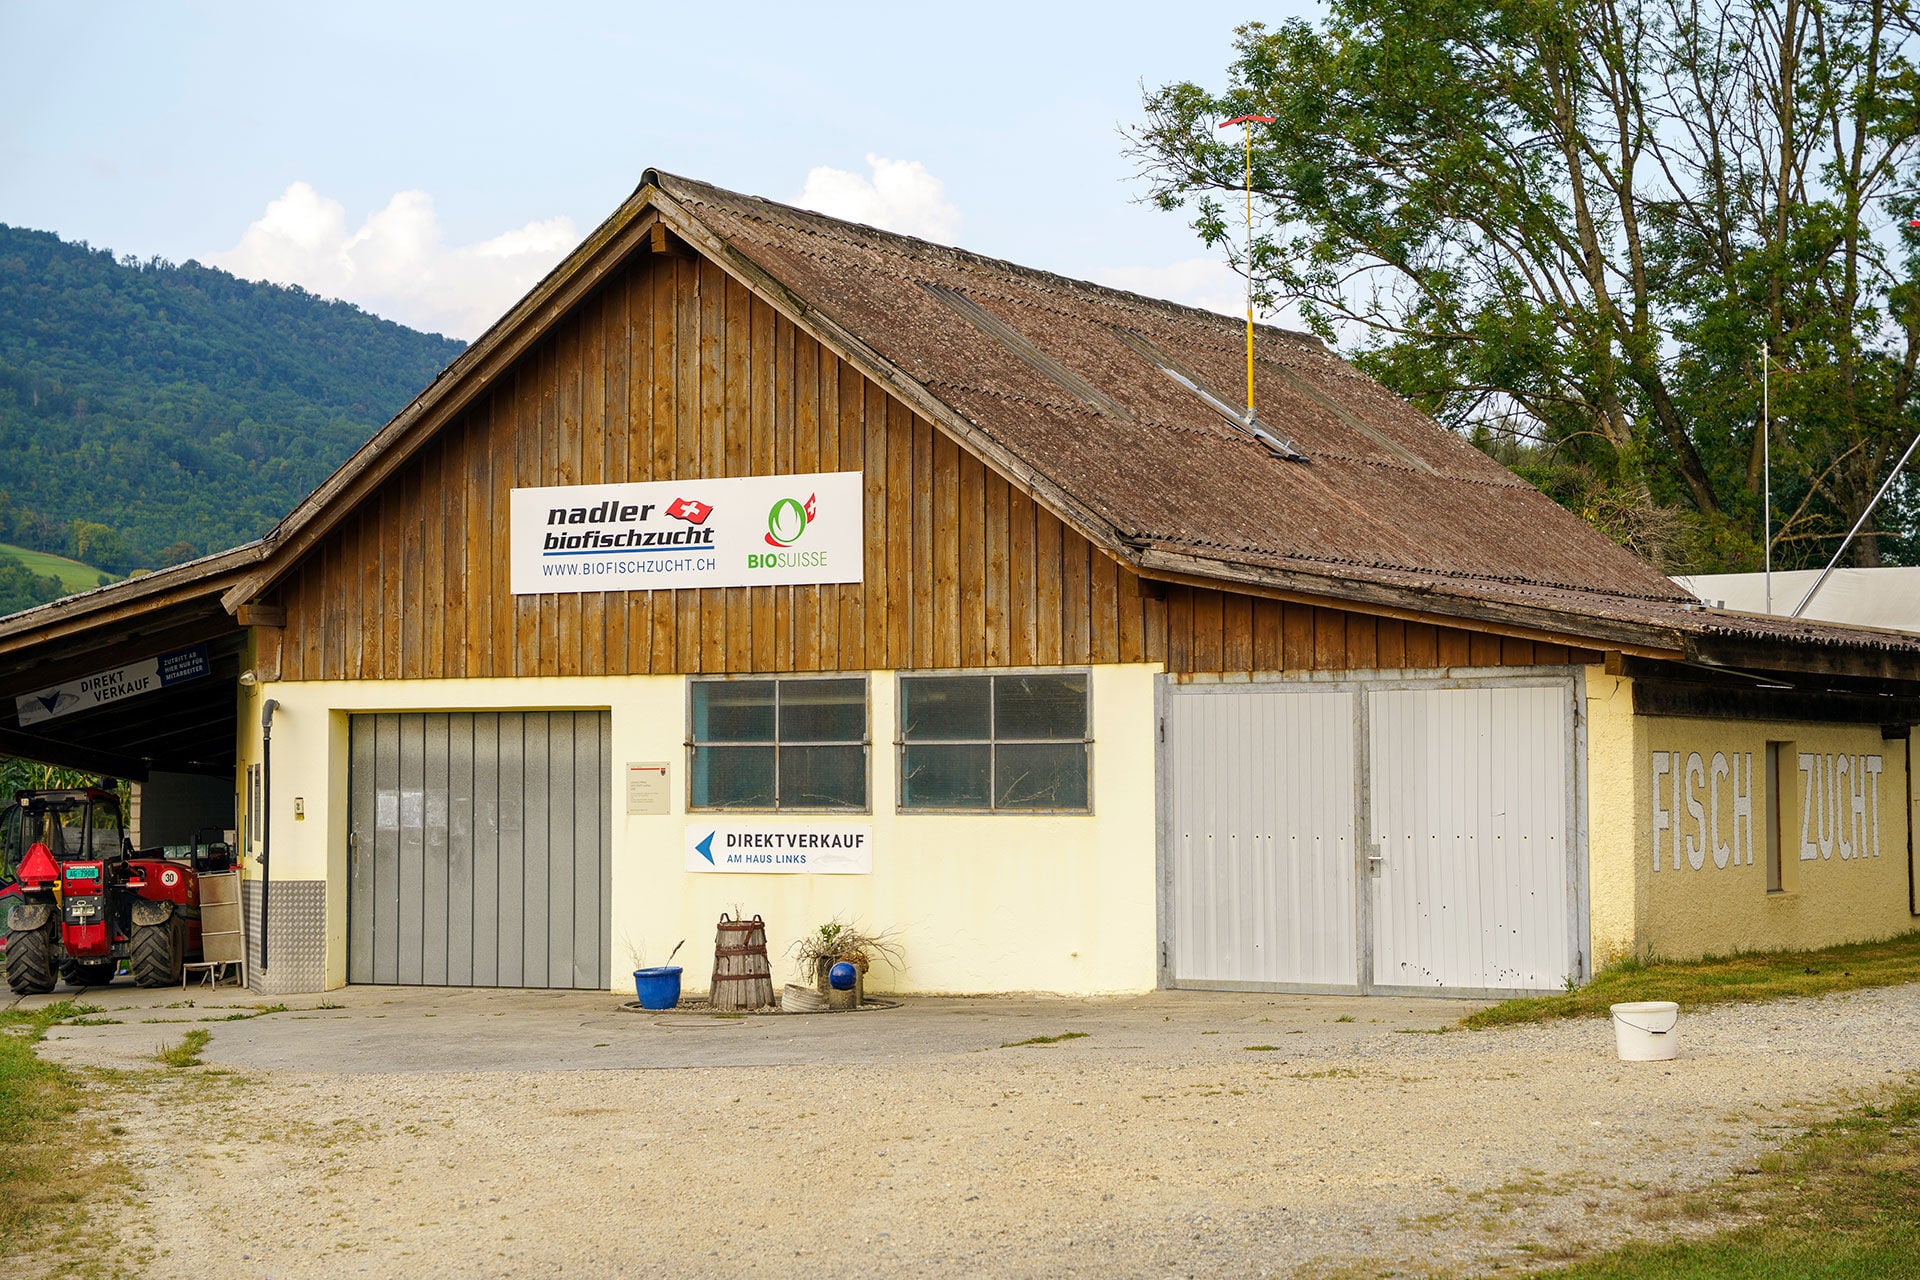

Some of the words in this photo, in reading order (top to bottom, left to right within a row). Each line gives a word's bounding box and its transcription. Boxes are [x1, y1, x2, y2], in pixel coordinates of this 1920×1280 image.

[547, 501, 655, 526] nadler
[543, 526, 715, 550] biofischzucht
[542, 558, 716, 576] WWW.BIOFISCHZUCHT.CH
[164, 653, 188, 666] ZUTRITT
[165, 664, 178, 673] HIER
[179, 660, 191, 669] NUR
[192, 657, 203, 665] FÜR
[81, 670, 124, 693] DIREKT
[165, 665, 203, 681] MITARBEITER
[94, 677, 150, 702] VERKAUF
[1652, 751, 1753, 872] FISCH
[1799, 753, 1883, 860] ZUCHT
[727, 833, 864, 848] DIREKTVERKAUF
[727, 855, 742, 864] AM
[745, 854, 772, 864] HAUS
[776, 854, 806, 864] LINKS
[165, 873, 175, 883] 30
